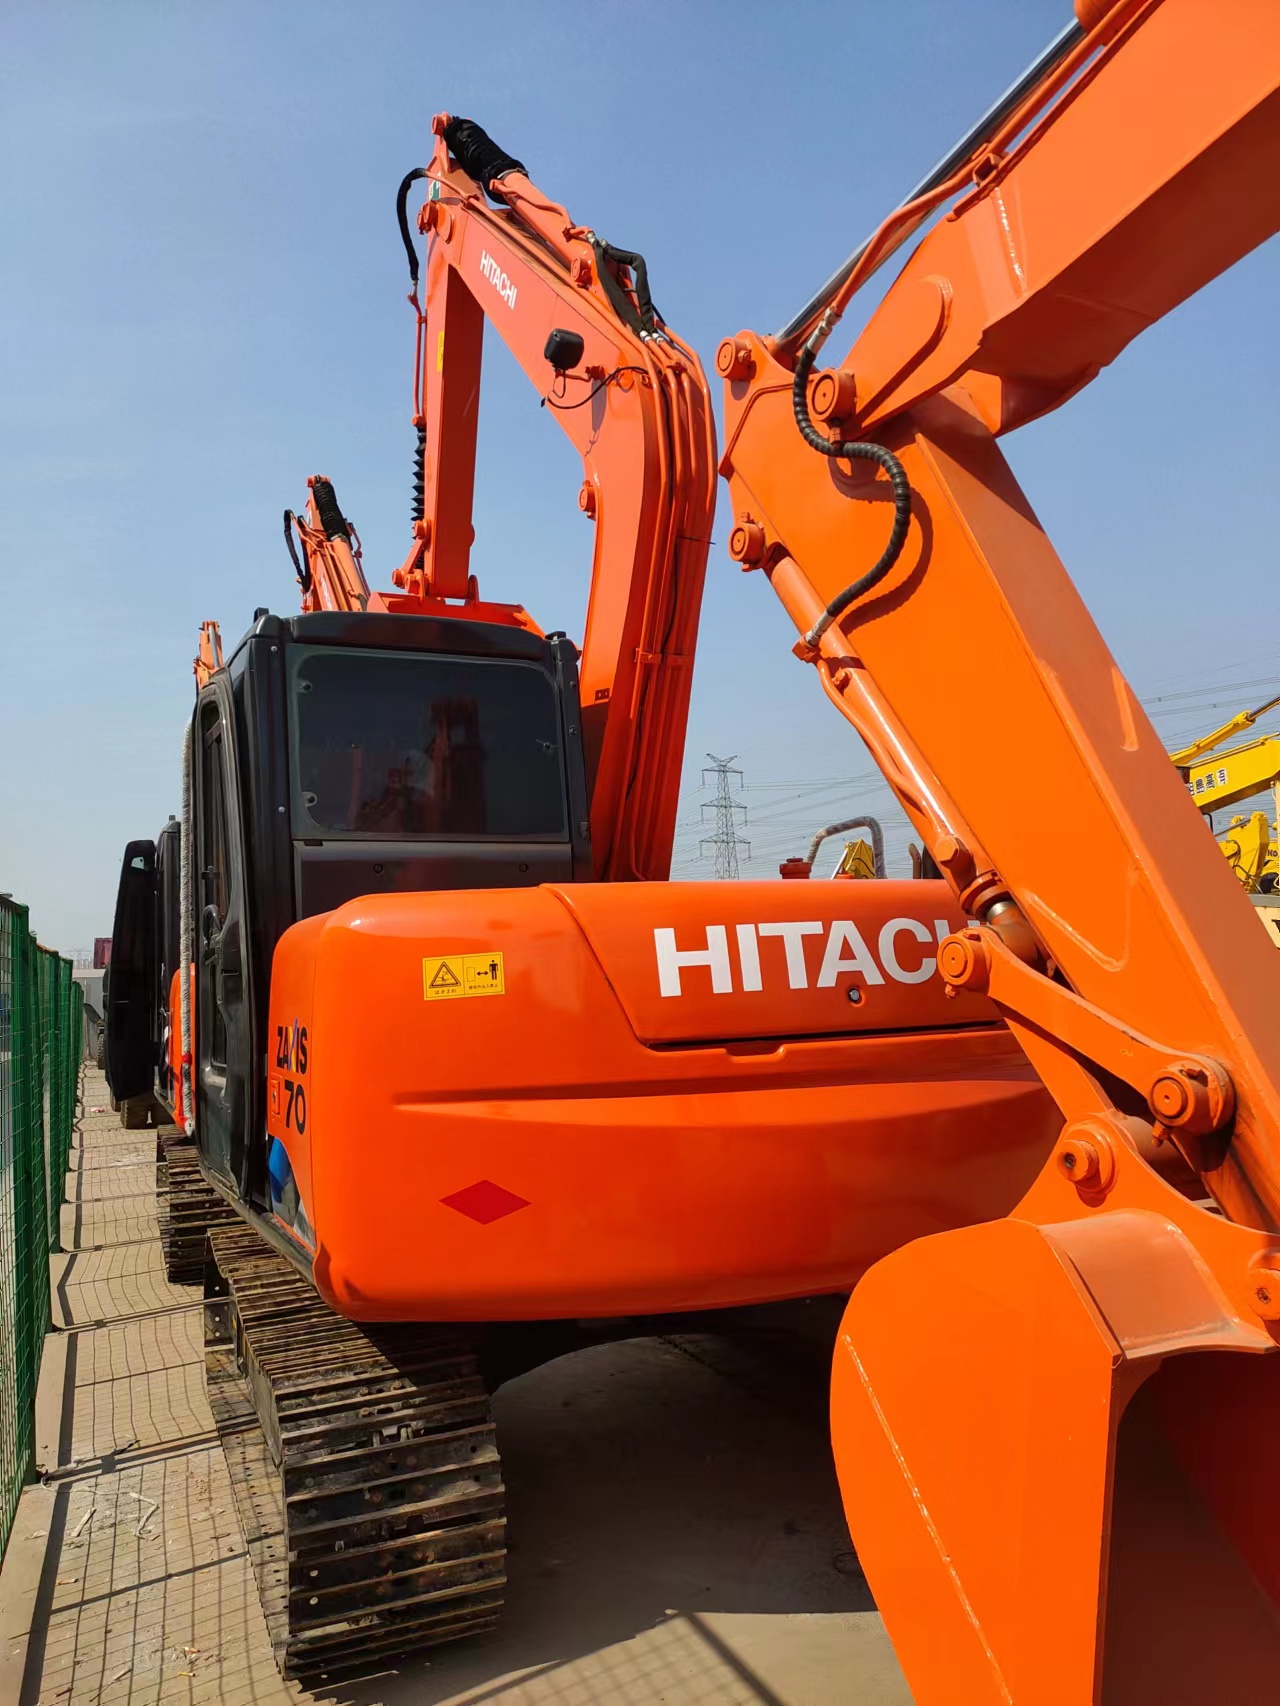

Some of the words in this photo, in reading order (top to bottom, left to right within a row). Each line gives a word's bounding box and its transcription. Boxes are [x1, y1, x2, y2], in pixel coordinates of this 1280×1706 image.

[480, 249, 517, 310] HITACHI
[653, 917, 985, 997] HITAC
[276, 1018, 308, 1074] ZAXIS
[284, 1079, 306, 1135] 70
